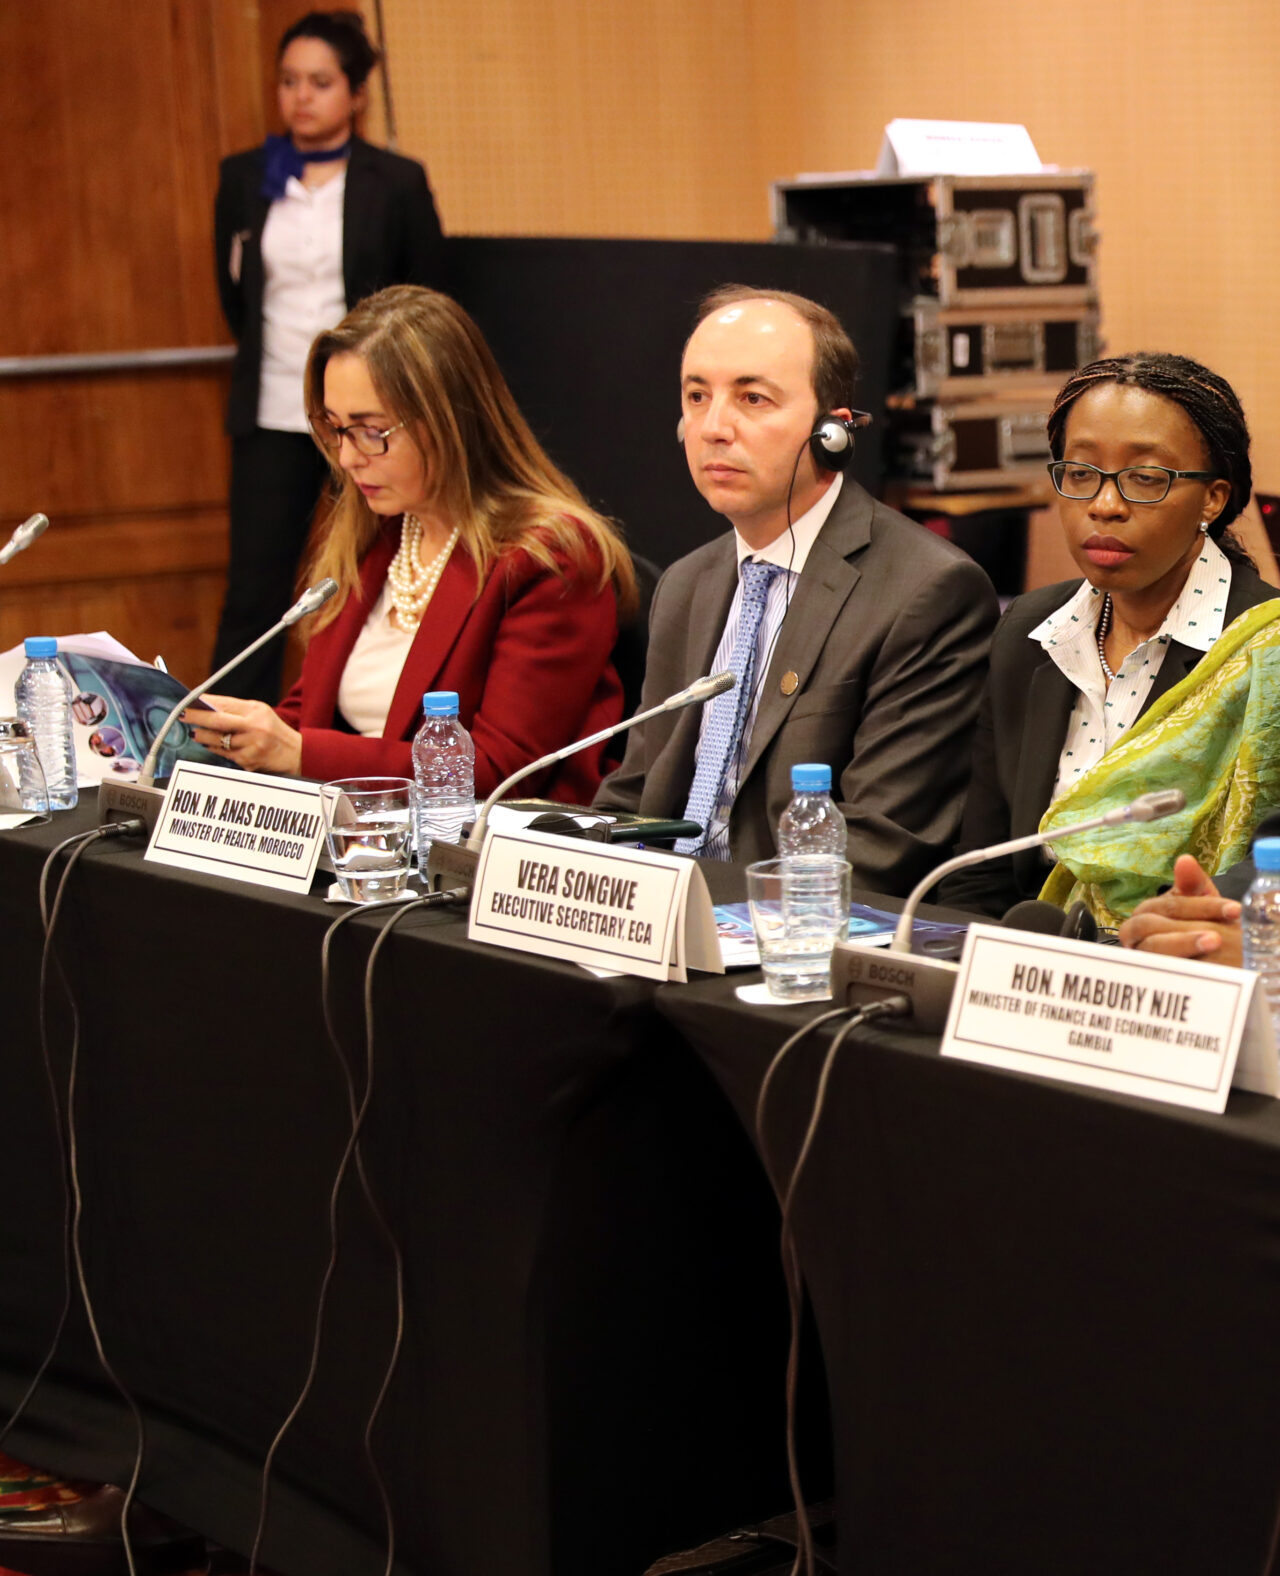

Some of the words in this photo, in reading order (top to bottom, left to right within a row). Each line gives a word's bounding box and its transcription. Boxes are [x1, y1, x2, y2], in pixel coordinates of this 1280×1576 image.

[169, 818, 208, 841] MINISTER
[212, 827, 224, 842] OF
[223, 829, 257, 852] HEALTH,
[257, 836, 305, 860] MOROCCO
[171, 789, 200, 816] HON.
[202, 795, 218, 819] M.
[218, 798, 255, 826] ANAS
[255, 805, 321, 839] DOUKKALI
[517, 859, 559, 896] VERA
[562, 868, 638, 911] SONGWE
[491, 892, 554, 924] EXECUTIVE
[556, 905, 626, 941] SECRETARY,
[628, 920, 652, 945] ECA
[868, 964, 916, 987] BOSCH
[1011, 963, 1055, 997] HON.
[1061, 973, 1147, 1013] MABURY
[1150, 990, 1191, 1022] NJIE
[968, 990, 1021, 1013] MINISTER
[1024, 1001, 1038, 1016] OF
[1039, 1004, 1086, 1026] FINANCE
[1089, 1013, 1112, 1031] AND
[1114, 1017, 1174, 1042] ECONOMIC
[1176, 1030, 1221, 1053] AFFAIRS
[1068, 1030, 1114, 1052] GAMBIA
